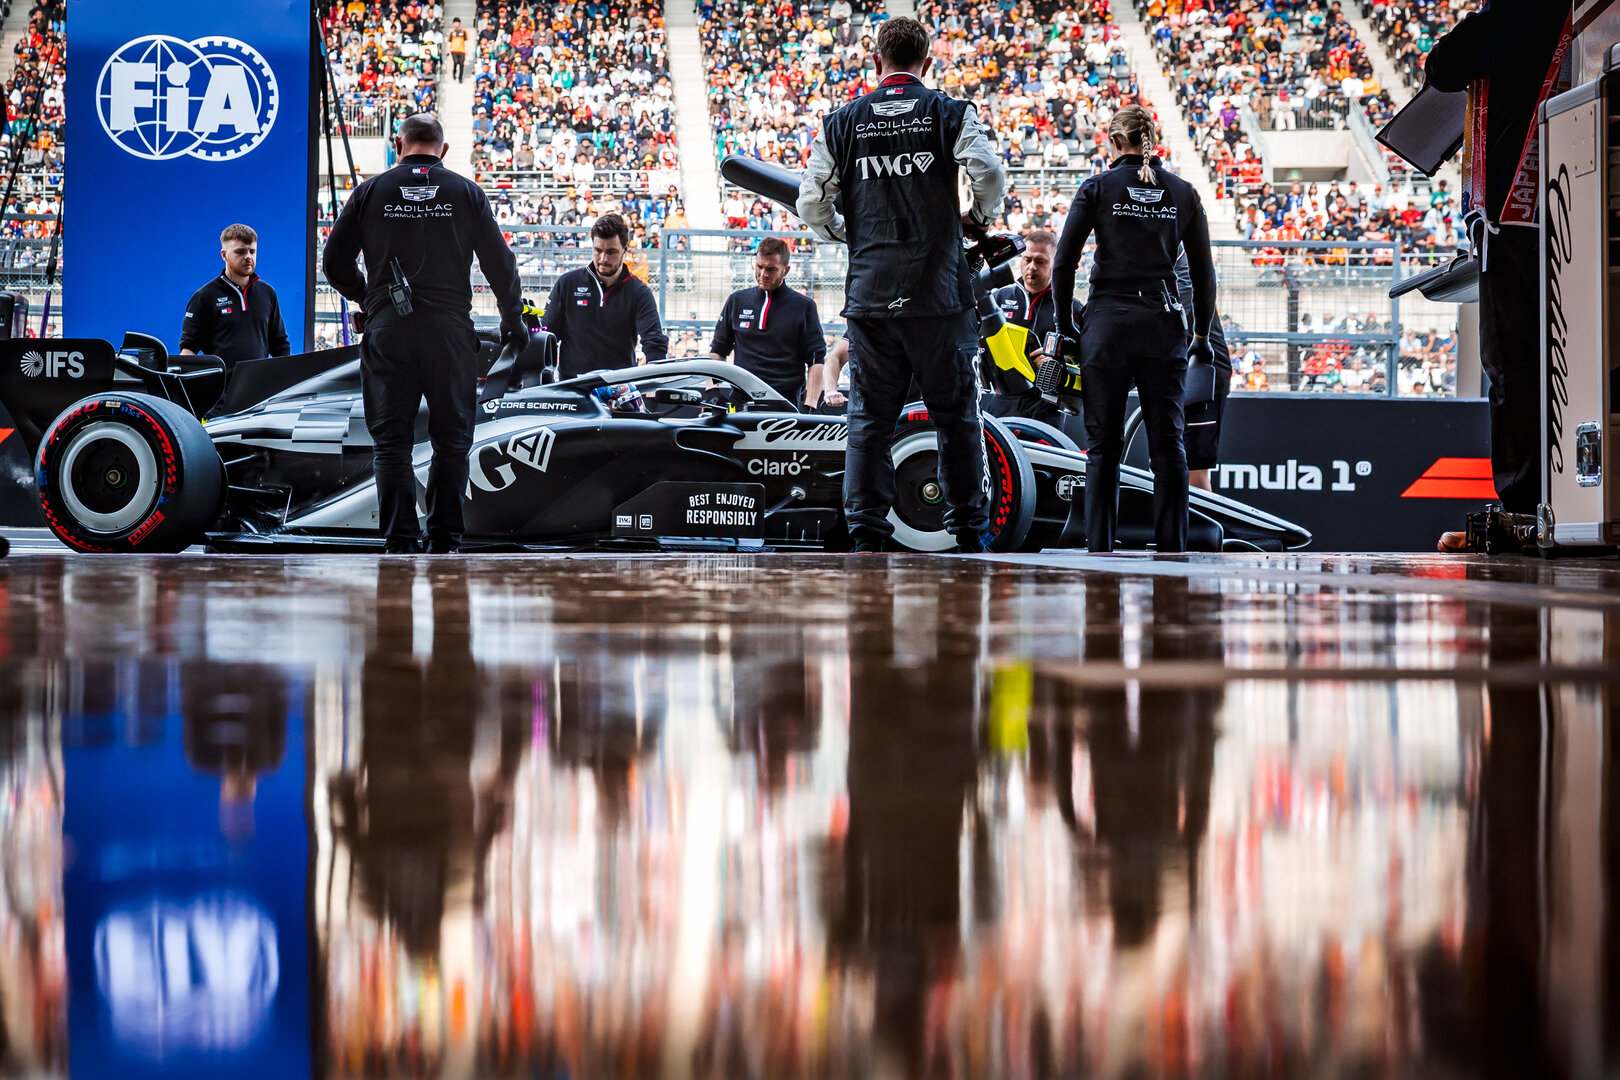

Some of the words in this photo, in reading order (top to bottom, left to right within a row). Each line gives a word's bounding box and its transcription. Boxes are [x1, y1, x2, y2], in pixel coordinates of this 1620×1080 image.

[856, 117, 932, 131] CADILLAC
[856, 130, 898, 139] FORMULA
[856, 153, 912, 180] TWG
[1511, 139, 1539, 219] JAPAN
[384, 203, 453, 212] CADILLAC
[1112, 203, 1177, 213] CADILLAC
[1548, 163, 1572, 473] Cadillac
[46, 351, 84, 378] IFS
[527, 402, 578, 411] SCIENTIFIC
[747, 458, 802, 475] Claro
[689, 493, 710, 507] BEST
[716, 493, 756, 508] ENJOYED
[686, 509, 758, 526] RESPONSIBLY
[128, 510, 166, 546] PIRELLI
